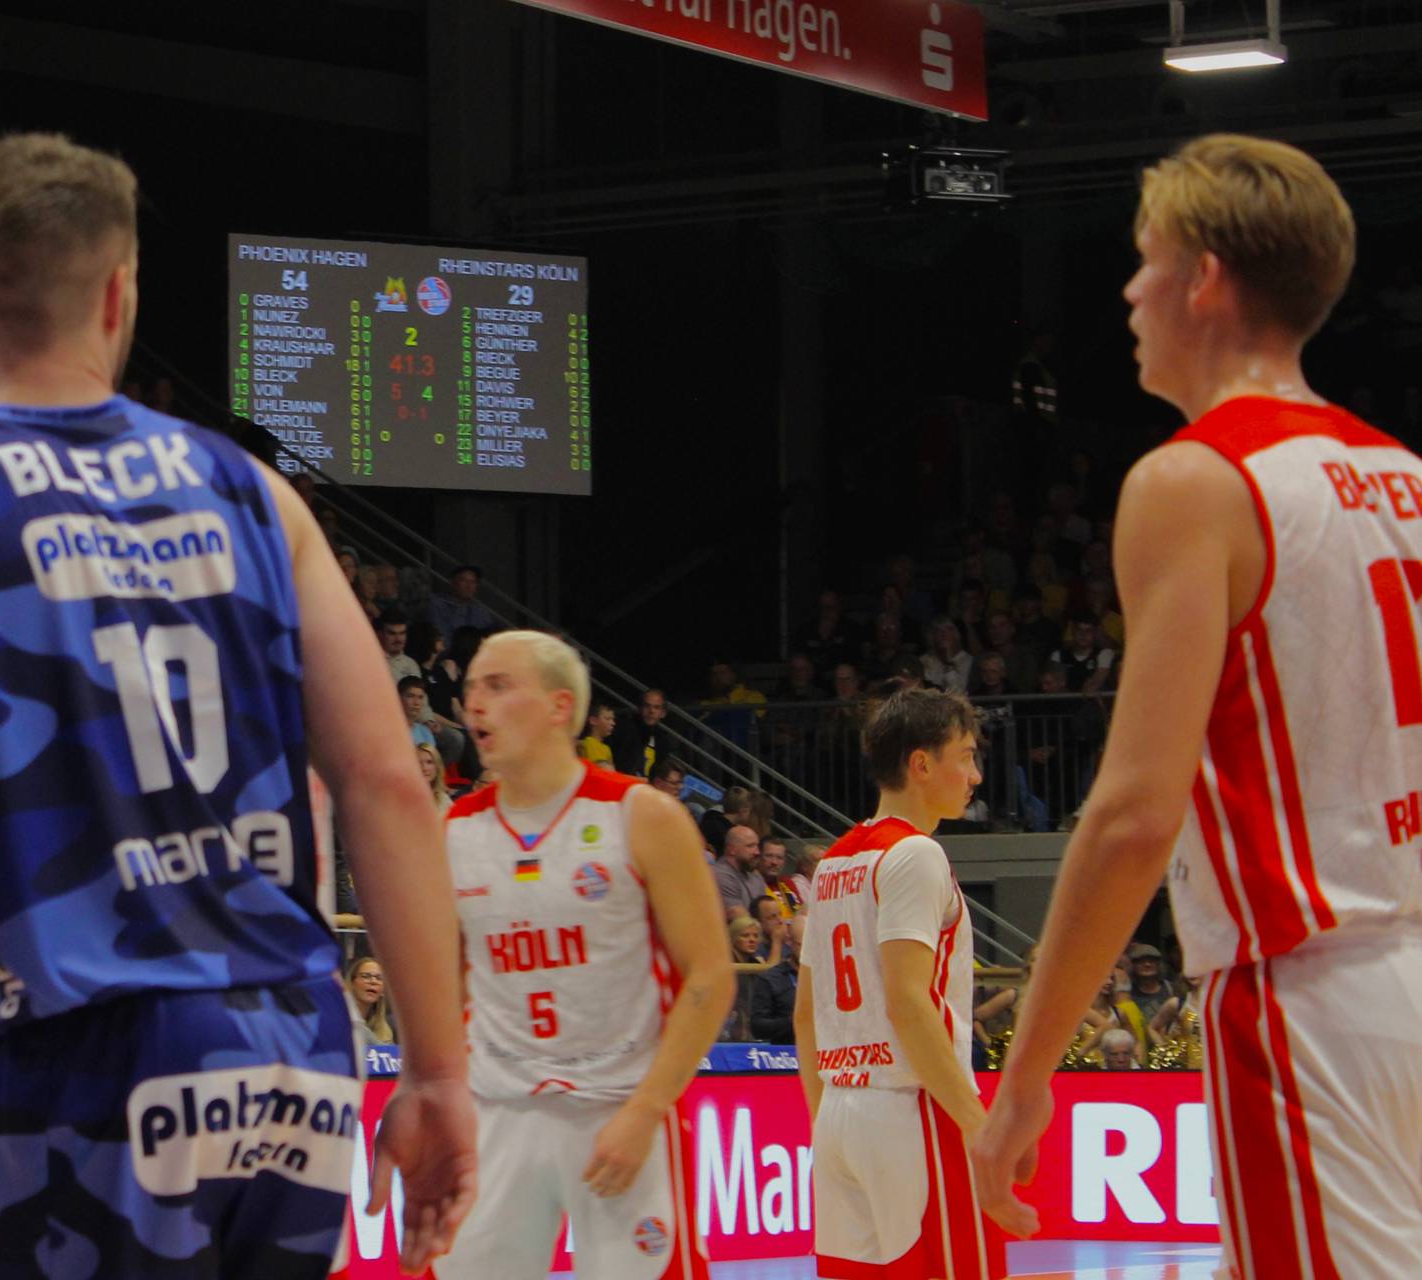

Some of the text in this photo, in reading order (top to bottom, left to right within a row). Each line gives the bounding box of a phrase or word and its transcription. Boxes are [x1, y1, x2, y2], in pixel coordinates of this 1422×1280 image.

[238, 244, 367, 267] PHOENIX HAGEN
[438, 258, 578, 282] RHEINSTARS KÖLN
[281, 269, 308, 291] 54
[253, 294, 309, 309] GRAVES
[508, 284, 534, 306] 29
[462, 306, 472, 320] 2
[475, 307, 543, 323] TREFZGER
[240, 324, 249, 336] 2
[253, 324, 326, 340] NAWROCKI
[350, 329, 360, 342] 3
[405, 326, 418, 347] 2
[462, 321, 472, 333] 5
[475, 322, 529, 337] HENNEN
[580, 329, 589, 341] 2
[239, 339, 249, 350] 4
[253, 339, 335, 355] KRAUSHAAR
[253, 353, 314, 368] SCHMIDT
[389, 354, 435, 377] 41.3
[475, 351, 516, 366] RIECK
[253, 368, 298, 382] BLECK
[351, 374, 360, 386] 2
[475, 367, 521, 380] BEGUE
[580, 372, 589, 384] 2
[234, 383, 250, 395] 13
[253, 383, 284, 397] VON
[391, 382, 402, 400] 5
[422, 384, 434, 402] 4
[476, 381, 515, 394] DAVIS
[253, 399, 328, 414] UHLEMANN
[476, 395, 535, 410] ROHWER
[253, 413, 316, 428] CARROLL
[476, 410, 522, 424] BEYER
[476, 439, 523, 453] MILLER
[476, 454, 526, 468] ELISIAS
[92, 621, 230, 794] 10
[485, 921, 588, 974] KÖLN
[832, 922, 863, 1012] 6
[527, 992, 559, 1039] 5
